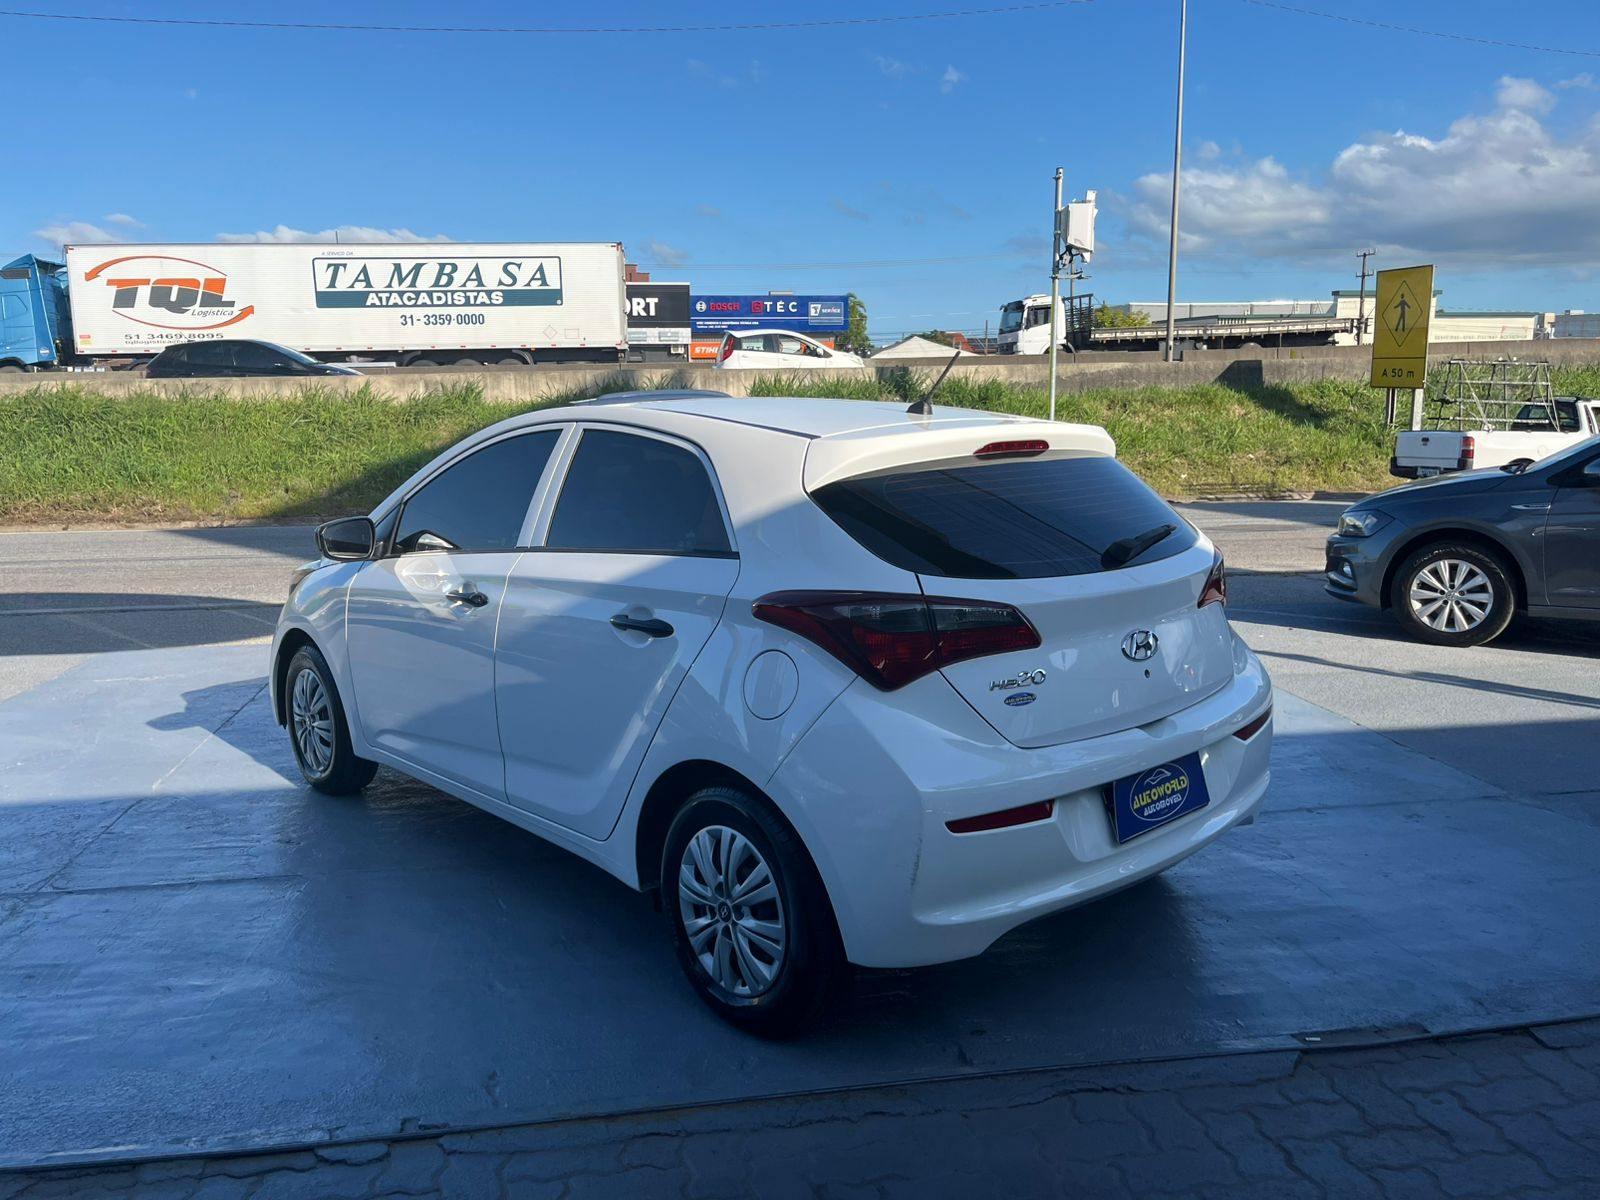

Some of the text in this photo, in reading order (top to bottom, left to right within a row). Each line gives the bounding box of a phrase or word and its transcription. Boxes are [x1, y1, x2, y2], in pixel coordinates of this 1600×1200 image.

[325, 261, 551, 289] TAMBASA
[106, 278, 235, 314] TQL
[365, 291, 504, 306] ATACADISTAS
[710, 302, 741, 311] BOSCH
[694, 346, 719, 354] STIH
[1382, 368, 1415, 378] A 50 m
[989, 668, 1047, 691] HB20
[1133, 776, 1188, 810] AUTOWORLD
